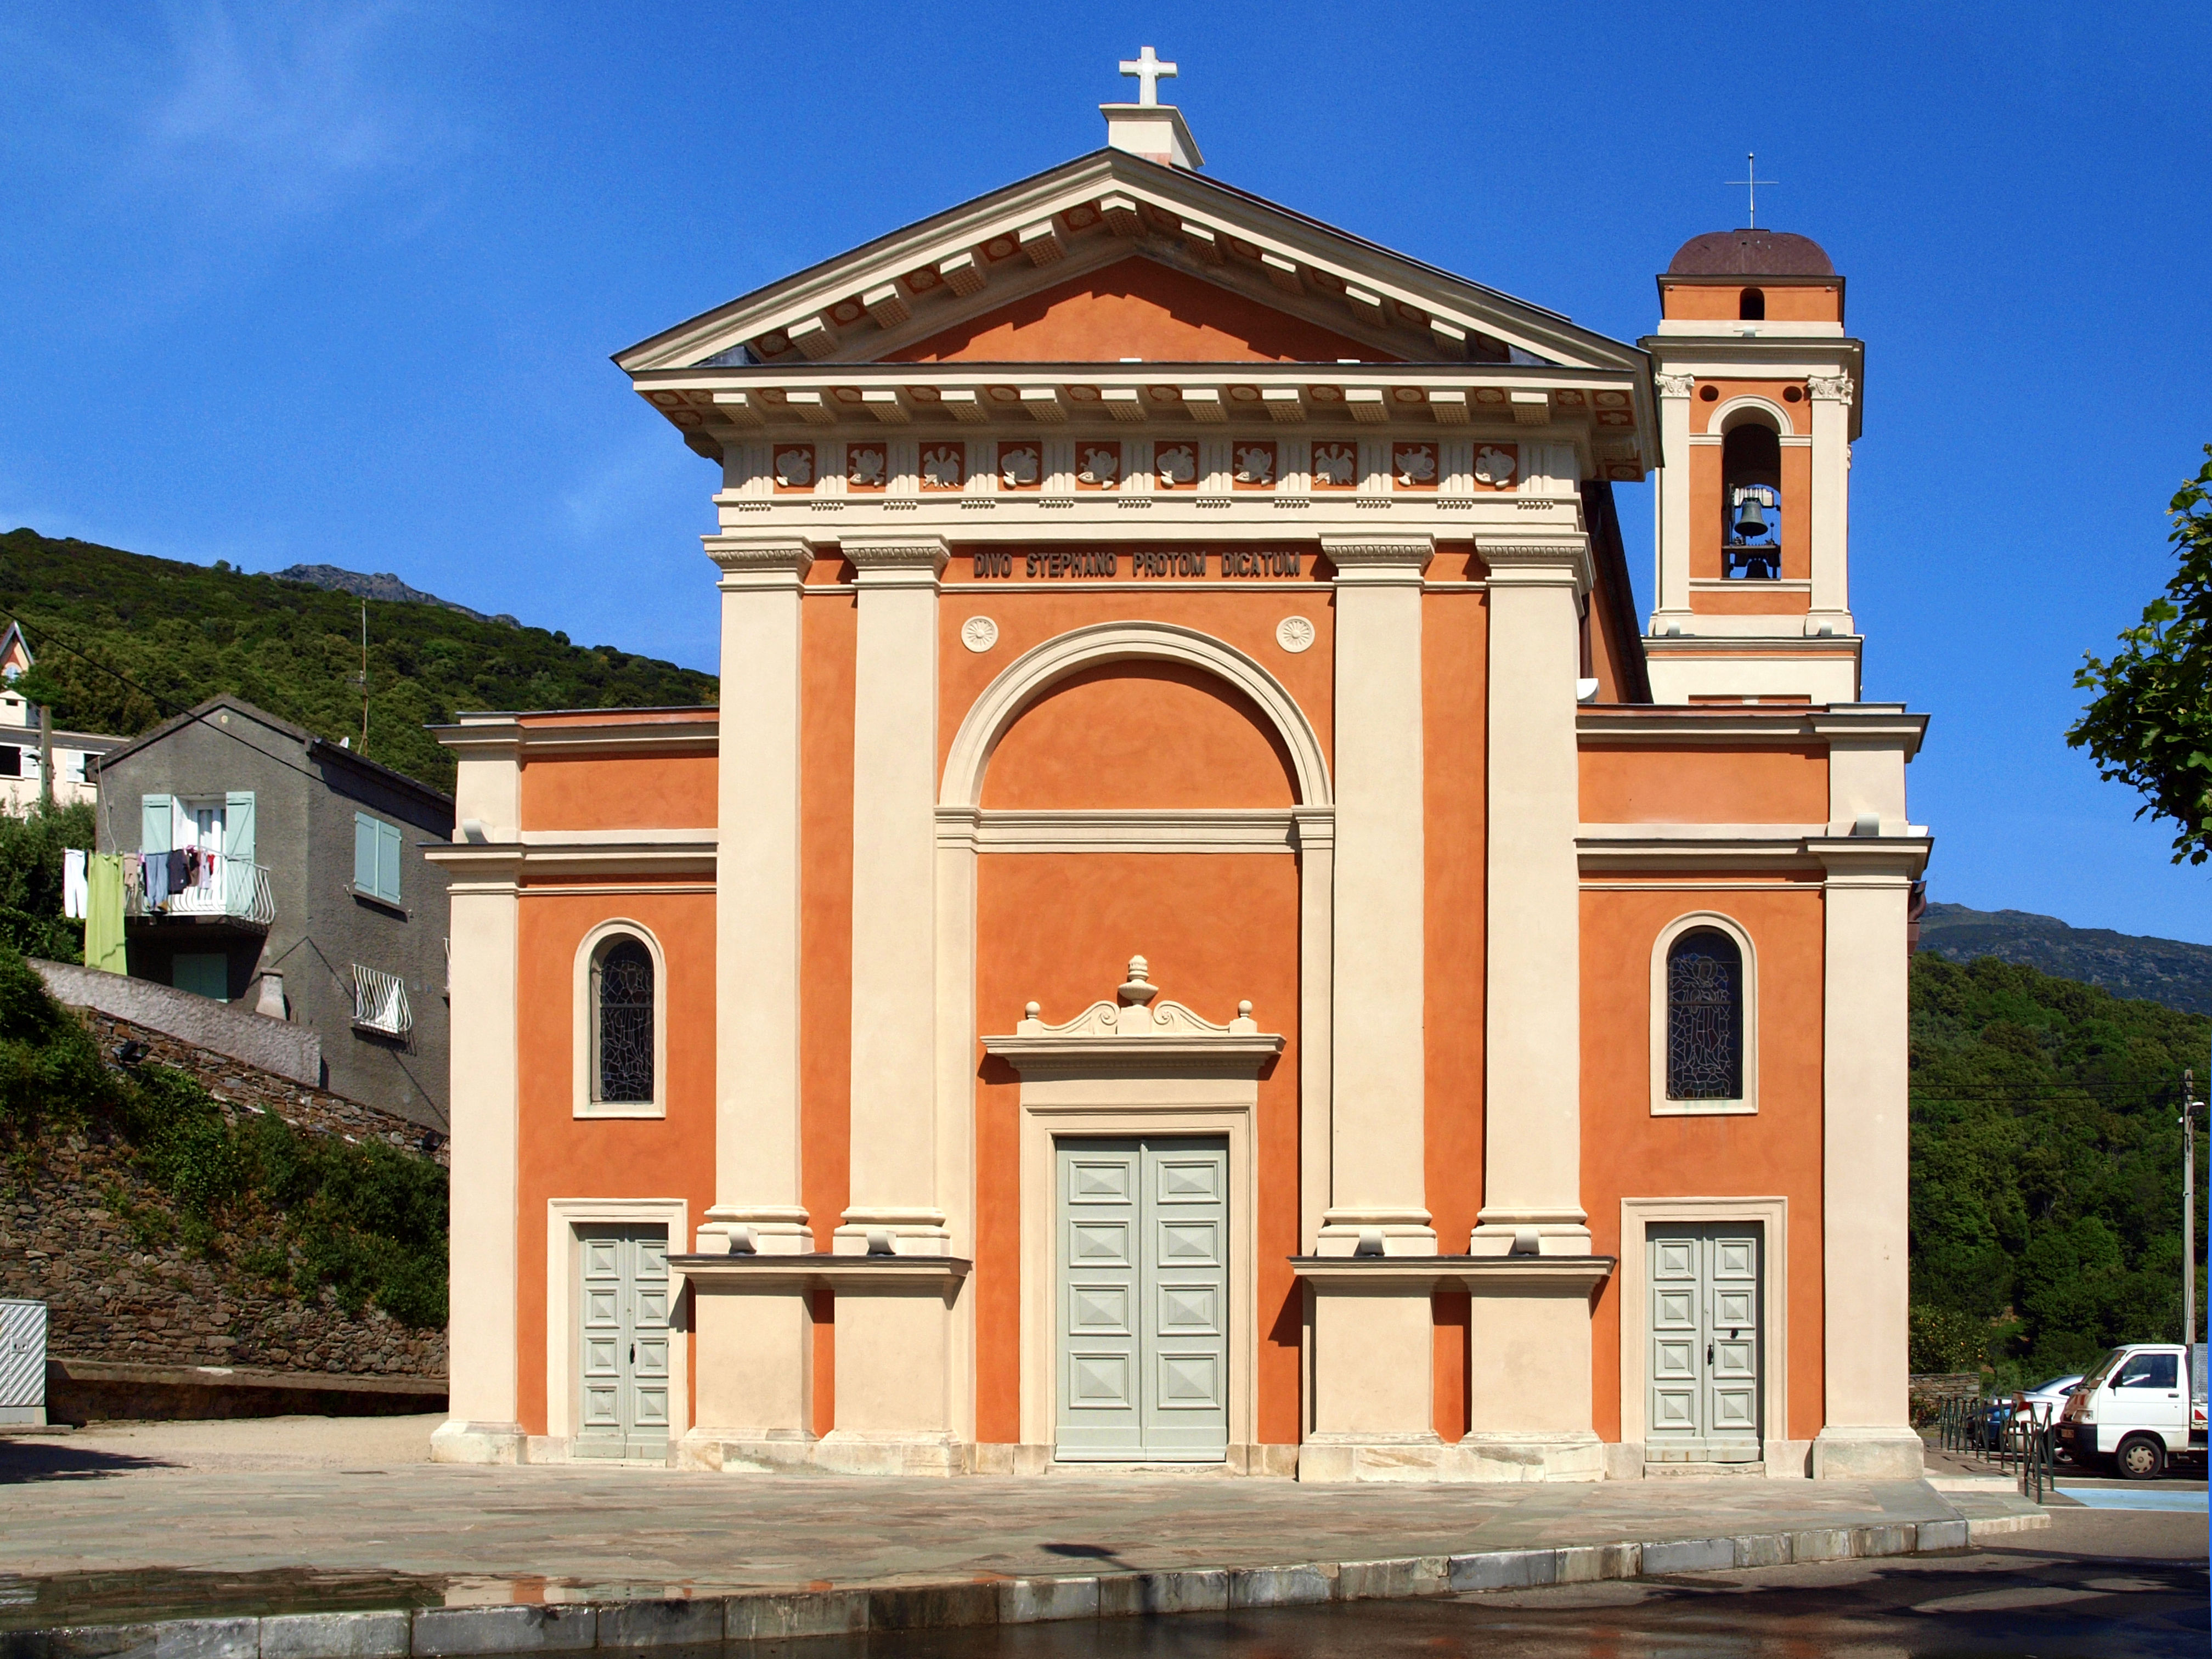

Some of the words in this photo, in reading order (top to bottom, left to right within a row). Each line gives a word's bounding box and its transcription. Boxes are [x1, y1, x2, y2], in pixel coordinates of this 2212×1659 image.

[974, 553, 1012, 577] DIVO
[1026, 552, 1117, 577] STEPHANO
[1133, 551, 1206, 576] PROTOM
[1222, 552, 1300, 576] DICATUM
